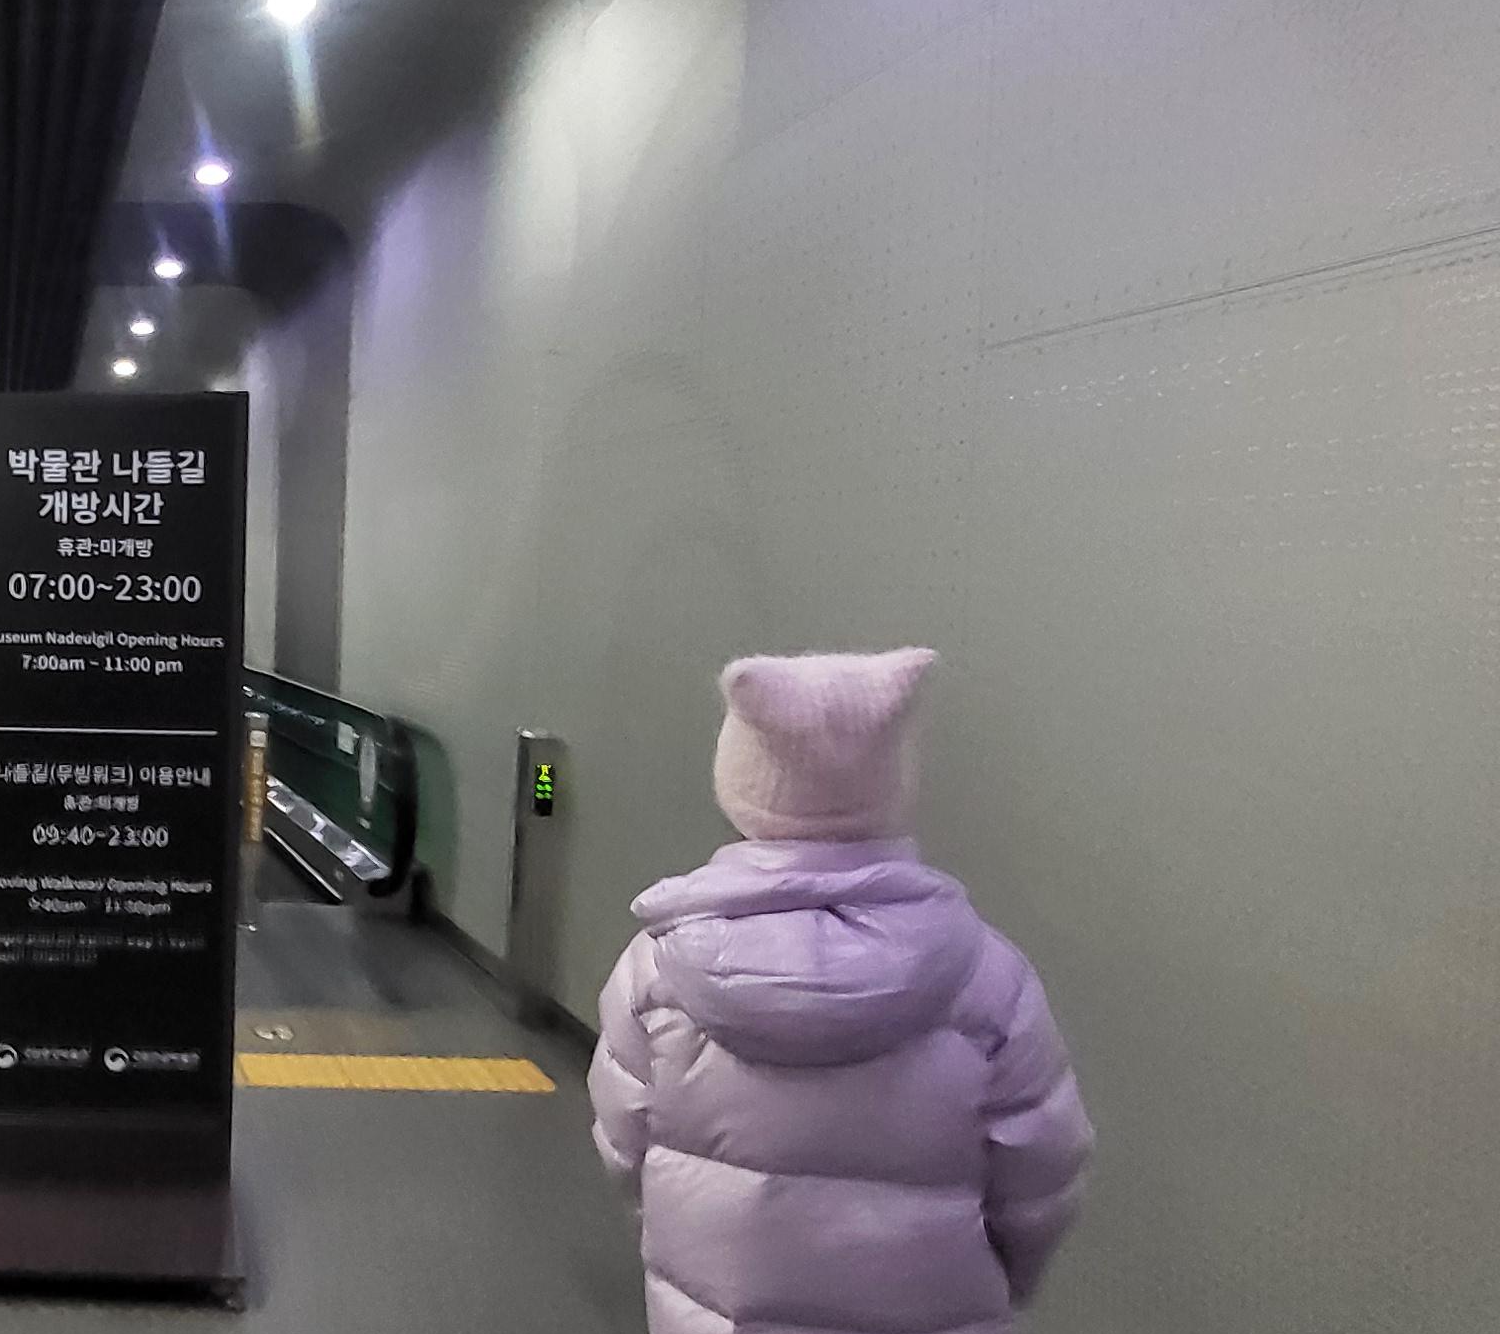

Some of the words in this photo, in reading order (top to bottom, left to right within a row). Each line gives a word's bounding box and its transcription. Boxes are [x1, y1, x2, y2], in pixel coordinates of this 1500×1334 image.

[8, 448, 102, 483] 박물관
[112, 450, 206, 485] 나들길
[39, 490, 165, 525] 개방시간
[57, 537, 153, 558] 휴관:미개방
[8, 572, 201, 603] 07:00~23:00
[46, 631, 114, 648] Nadeulgil
[117, 632, 177, 650] Opening
[181, 634, 225, 648] Hours
[22, 654, 86, 671] 7:00am
[104, 656, 151, 672] 11:00
[155, 659, 184, 675] pm
[139, 766, 212, 788] 이용안내
